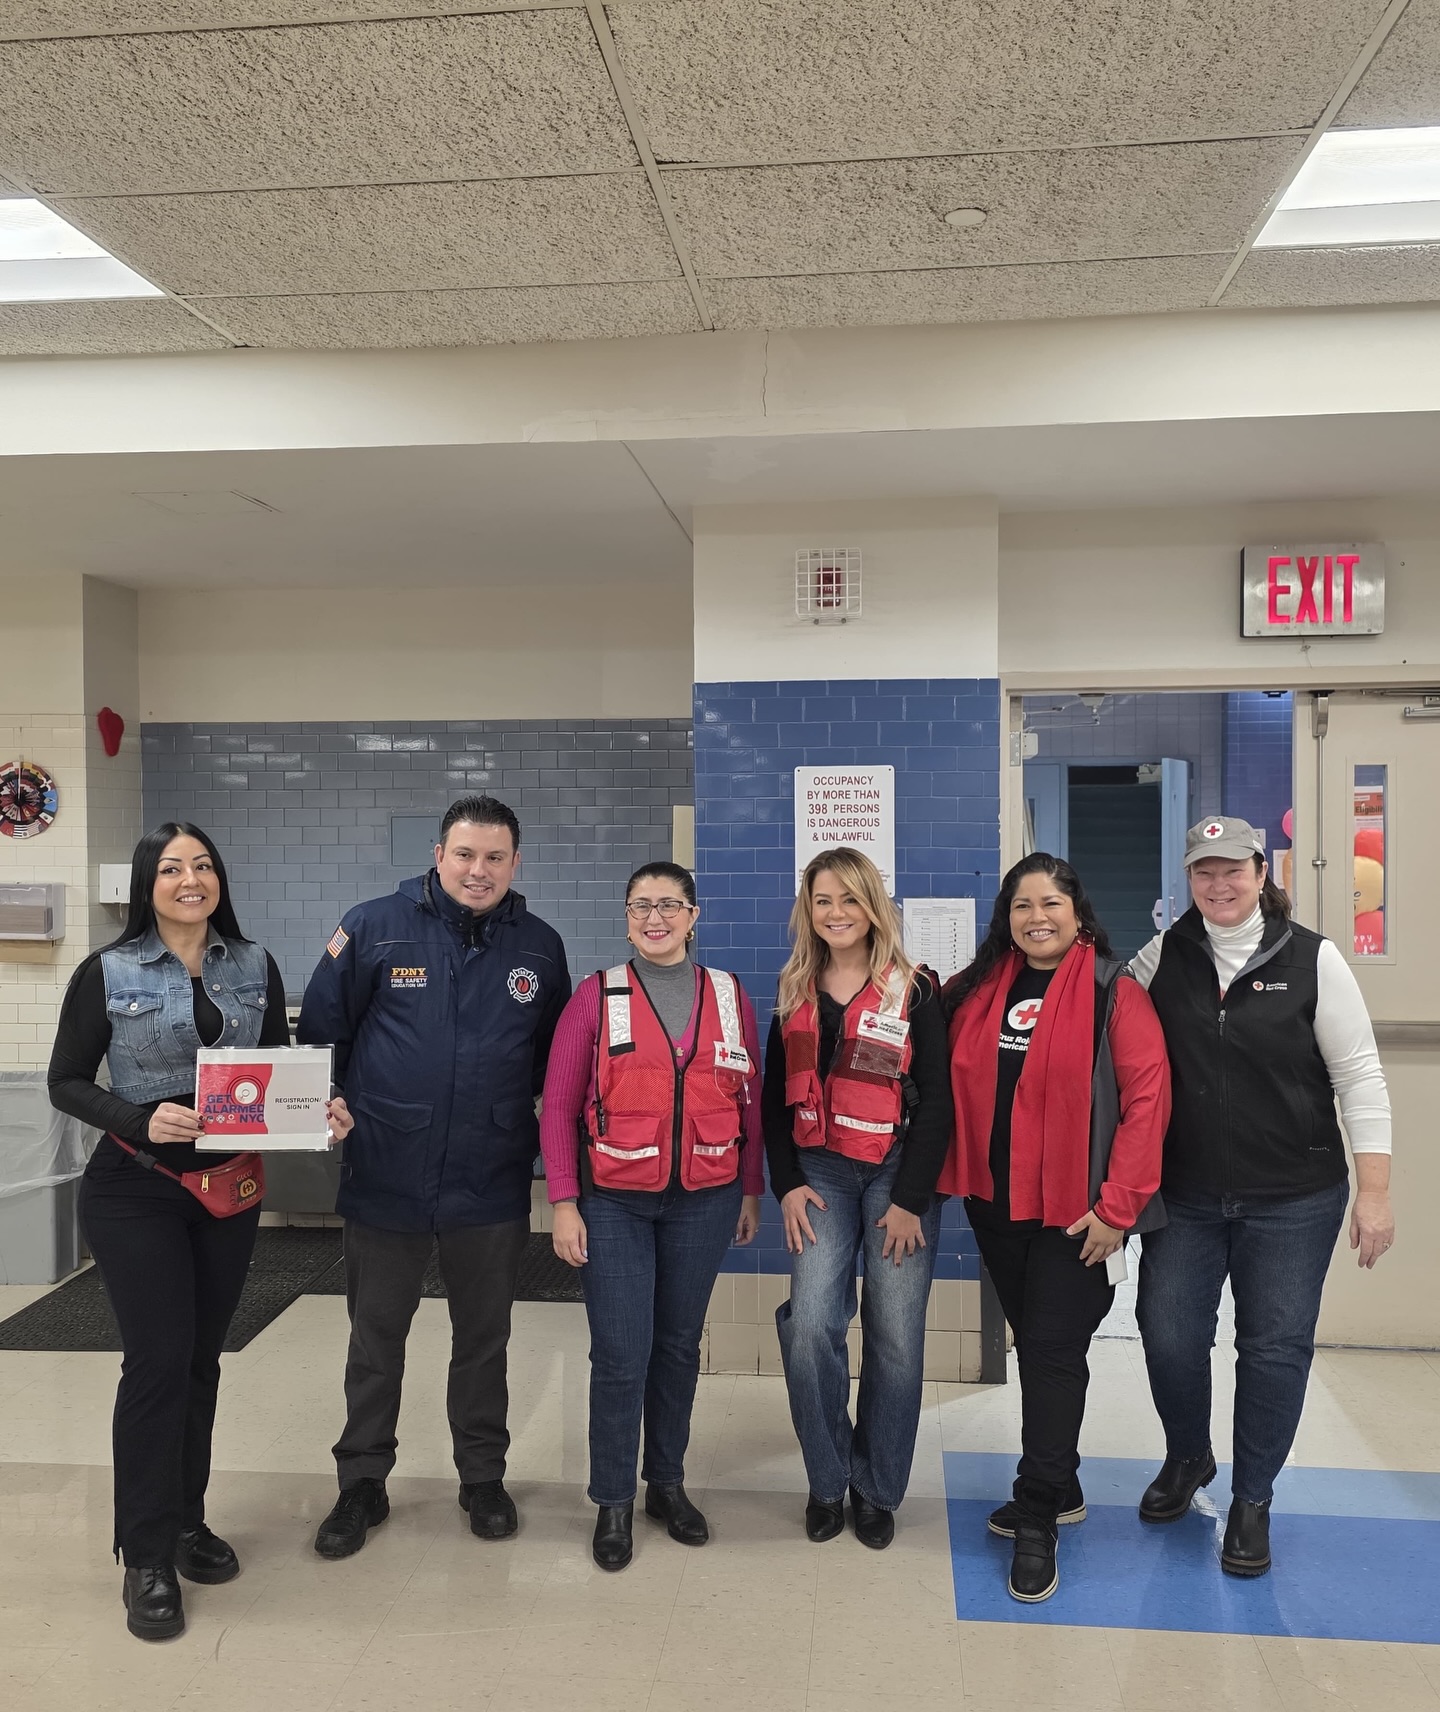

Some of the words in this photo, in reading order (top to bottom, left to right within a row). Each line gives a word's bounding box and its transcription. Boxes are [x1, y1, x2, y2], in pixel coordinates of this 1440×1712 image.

[1268, 555, 1360, 624] EXIT
[813, 776, 874, 786] OCCUPANCY
[807, 790, 820, 800] BY
[823, 790, 851, 800] MORE
[854, 790, 880, 799] THAN
[808, 803, 828, 815] 398
[834, 804, 880, 814] PERSONS
[807, 818, 816, 828] IS
[819, 818, 880, 828] DANGEROUS
[812, 832, 819, 841] &
[822, 832, 875, 841] UNLAWFUL
[391, 967, 426, 976] FDNY
[1015, 1036, 1030, 1045] Roj
[206, 1094, 232, 1104] GET
[204, 1104, 264, 1114] ALARMED
[239, 1114, 264, 1124] NYC
